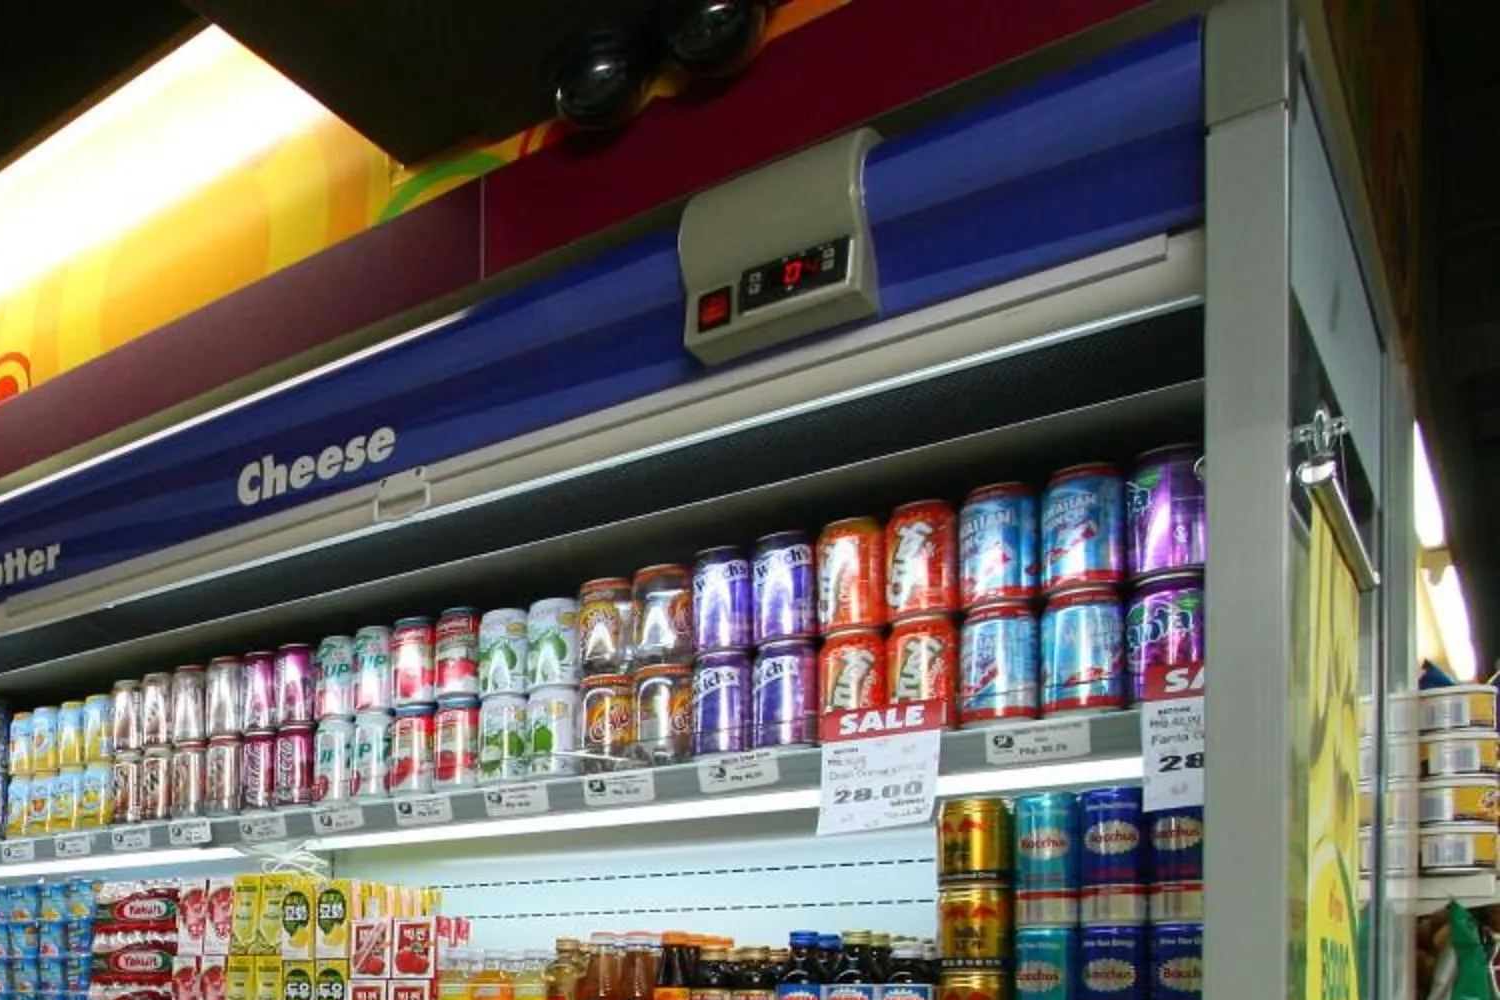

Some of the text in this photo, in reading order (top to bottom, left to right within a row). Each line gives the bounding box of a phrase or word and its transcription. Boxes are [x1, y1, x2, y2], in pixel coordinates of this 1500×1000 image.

[236, 425, 396, 507] Cheese
[1164, 667, 1205, 694] SA
[839, 704, 925, 735] SALE
